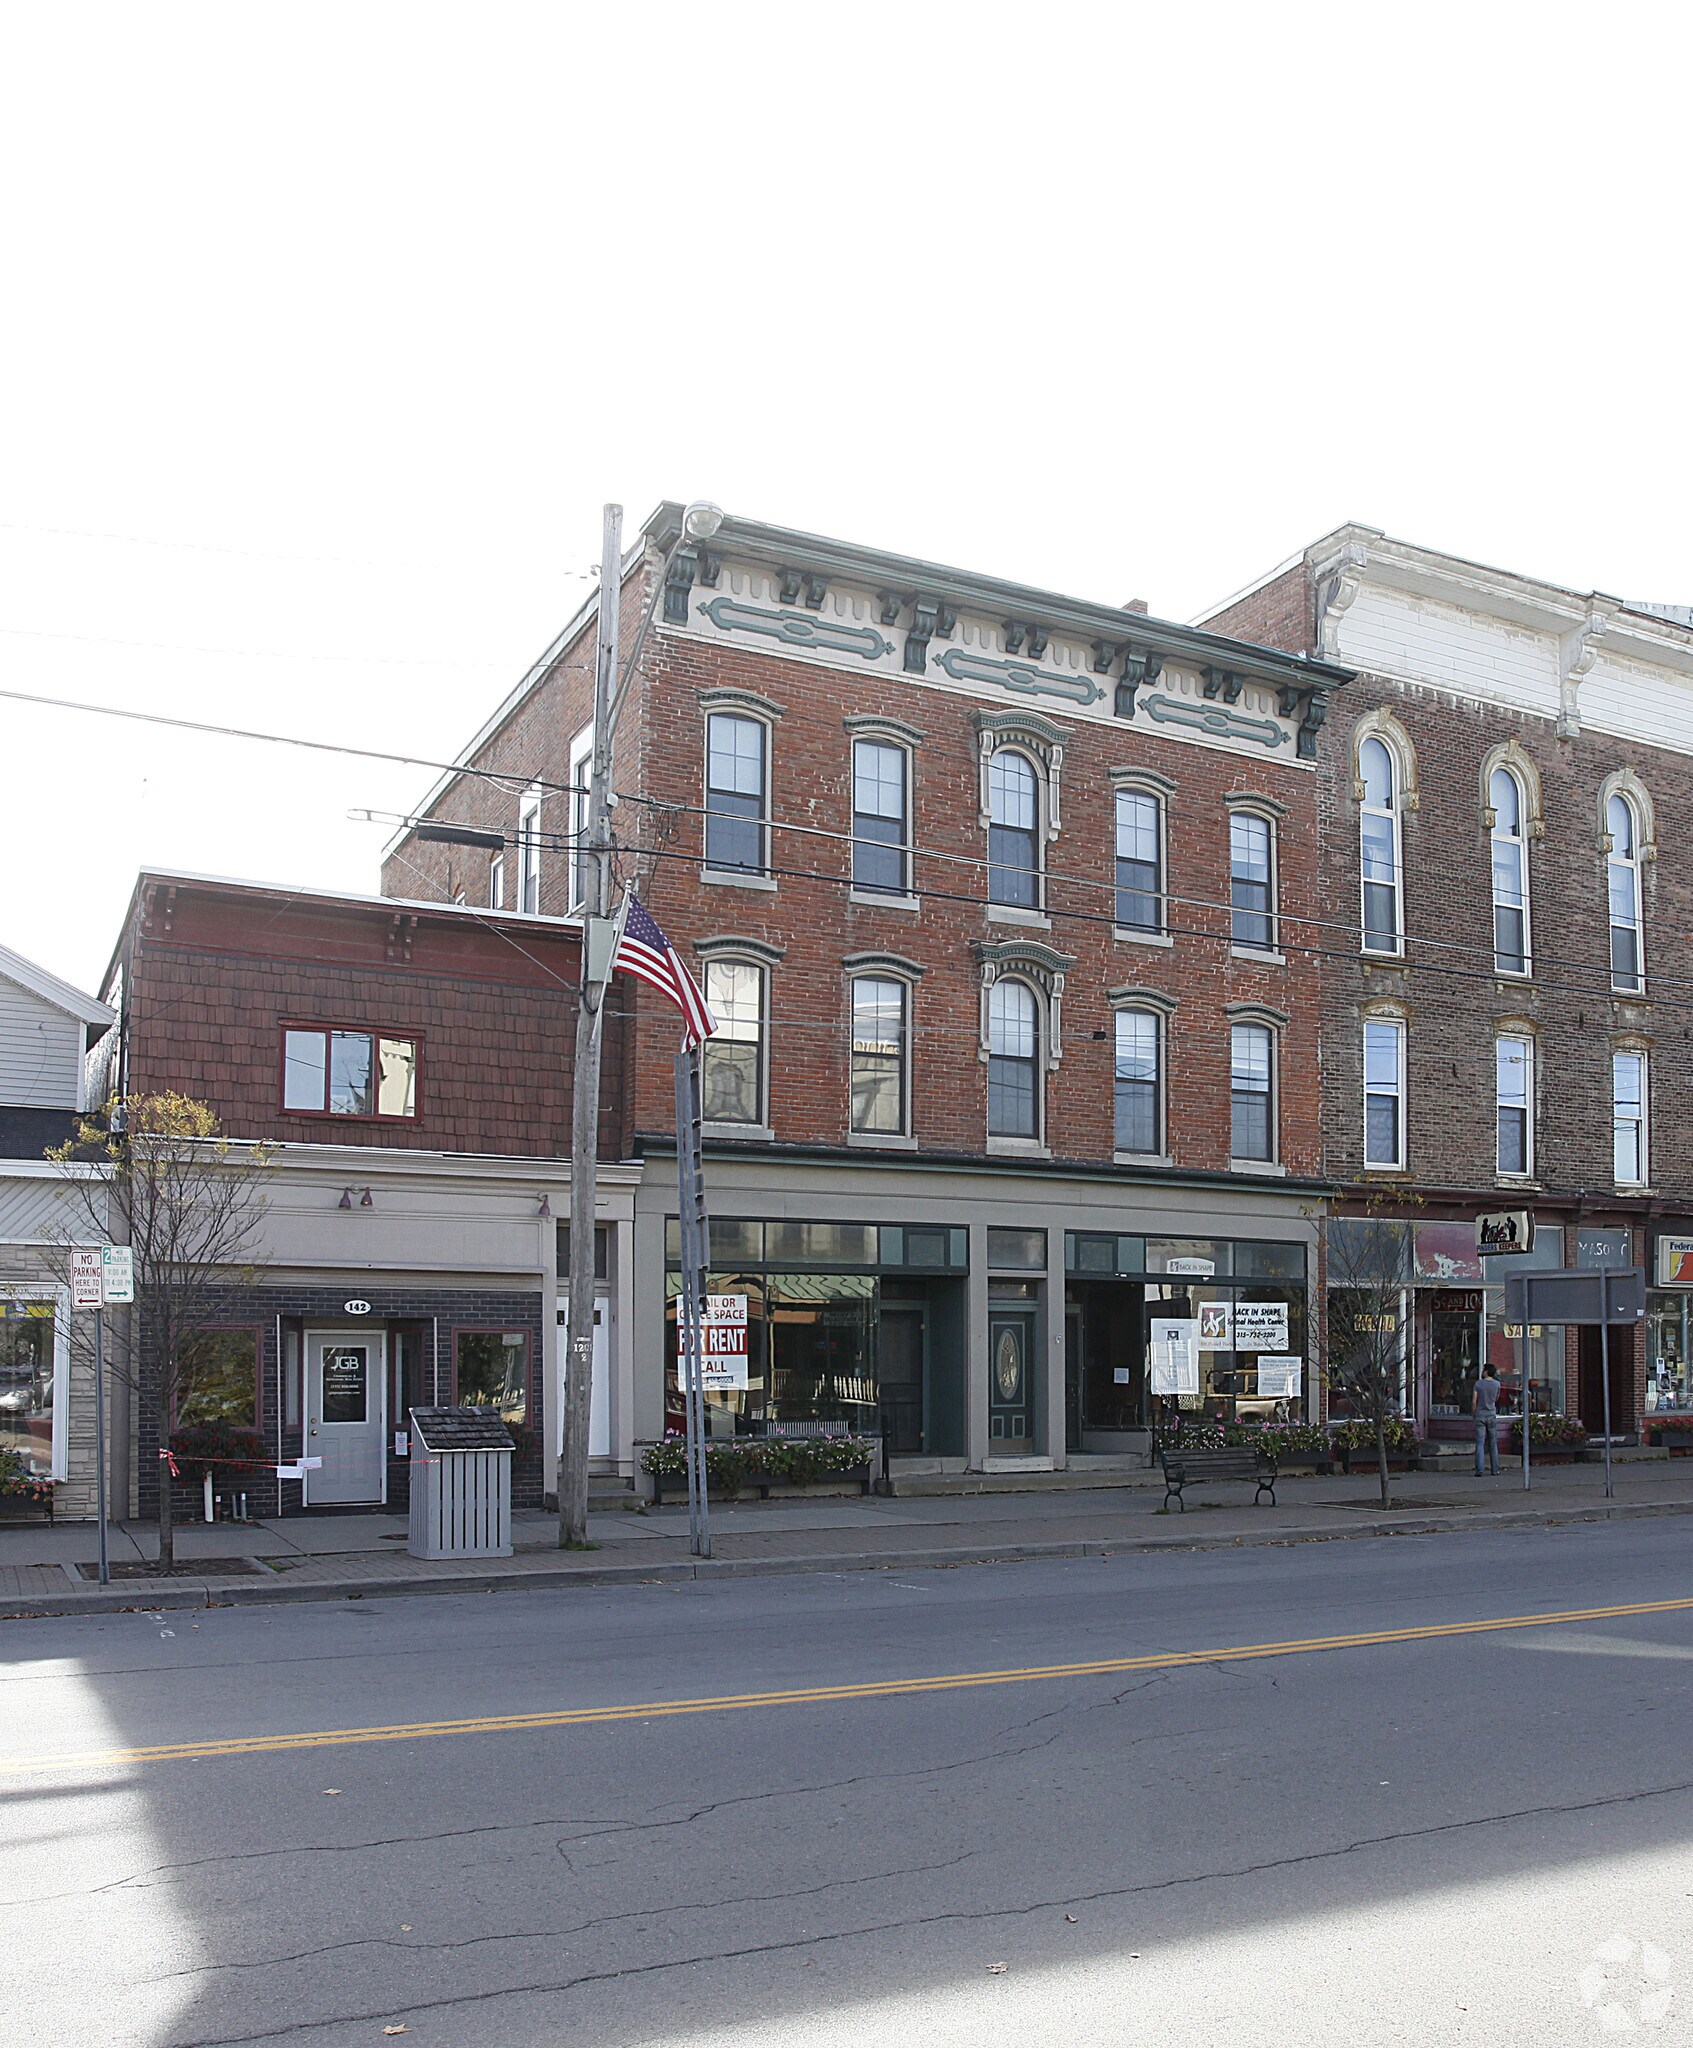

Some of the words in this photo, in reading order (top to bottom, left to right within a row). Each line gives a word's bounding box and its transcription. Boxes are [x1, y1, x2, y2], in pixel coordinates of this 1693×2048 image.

[1499, 1242, 1521, 1250] KEEPERS
[81, 1254, 92, 1265] NO
[104, 1250, 111, 1263] 2
[74, 1267, 101, 1278] PARKING
[76, 1279, 91, 1287] HERE
[92, 1279, 99, 1287] TO
[77, 1288, 99, 1296] CORNER
[349, 1303, 367, 1311] 142
[722, 1298, 736, 1308] OR
[714, 1310, 744, 1320] SPACE
[1251, 1308, 1259, 1316] IN
[1247, 1318, 1266, 1326] Health
[1507, 1325, 1536, 1337] SAE
[709, 1328, 746, 1352] RENT
[581, 1353, 588, 1362] 2
[331, 1356, 360, 1371] JGB
